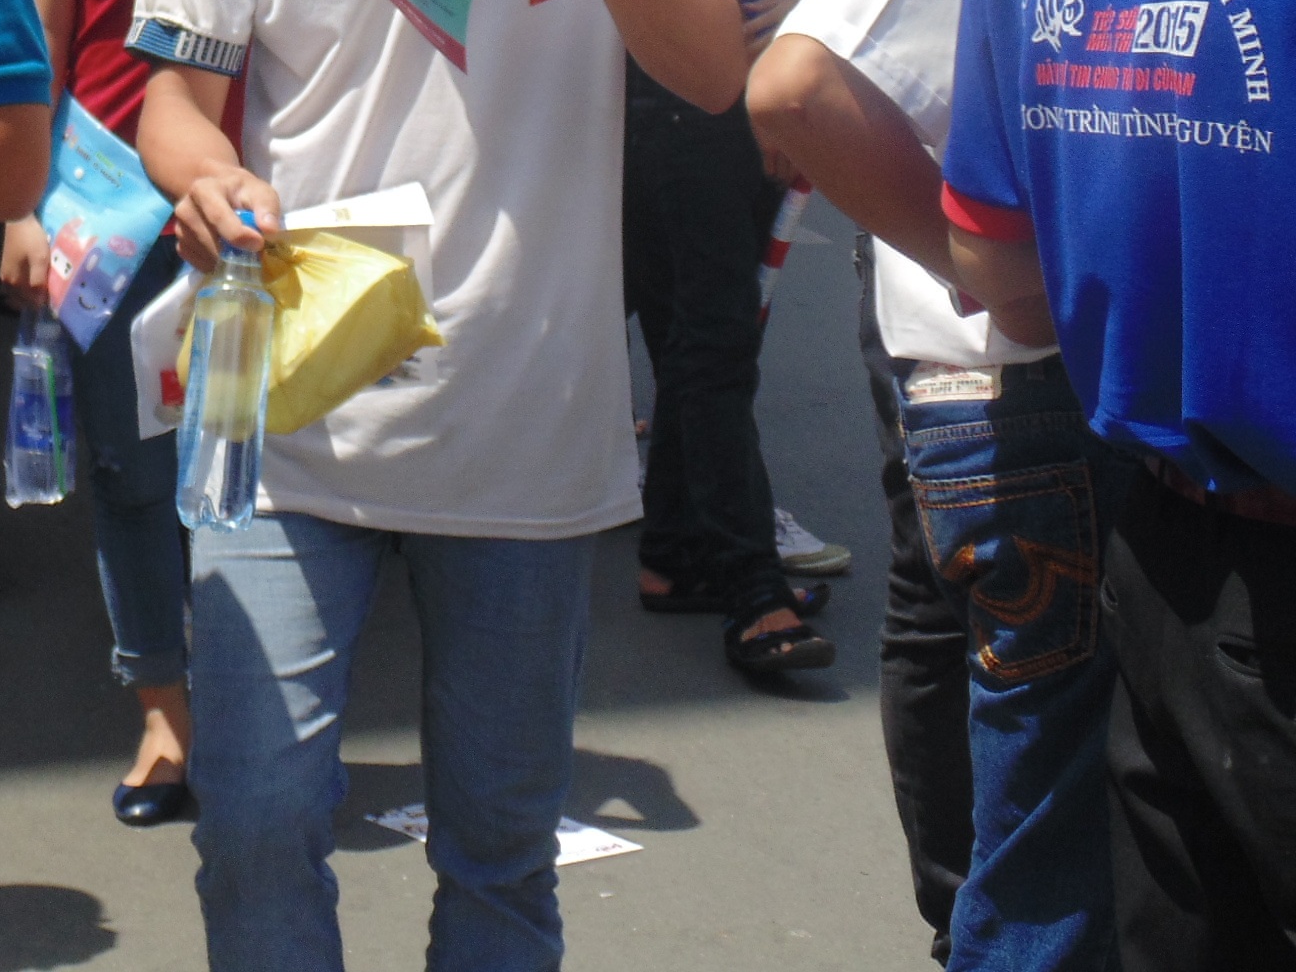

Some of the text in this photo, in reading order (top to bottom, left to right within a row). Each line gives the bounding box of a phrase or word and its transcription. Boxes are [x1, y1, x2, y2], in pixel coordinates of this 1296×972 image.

[1135, 5, 1201, 52] 2015
[1227, 8, 1271, 103] MINH
[1064, 103, 1121, 136] TRÌNH
[1122, 107, 1178, 137] TÌNH
